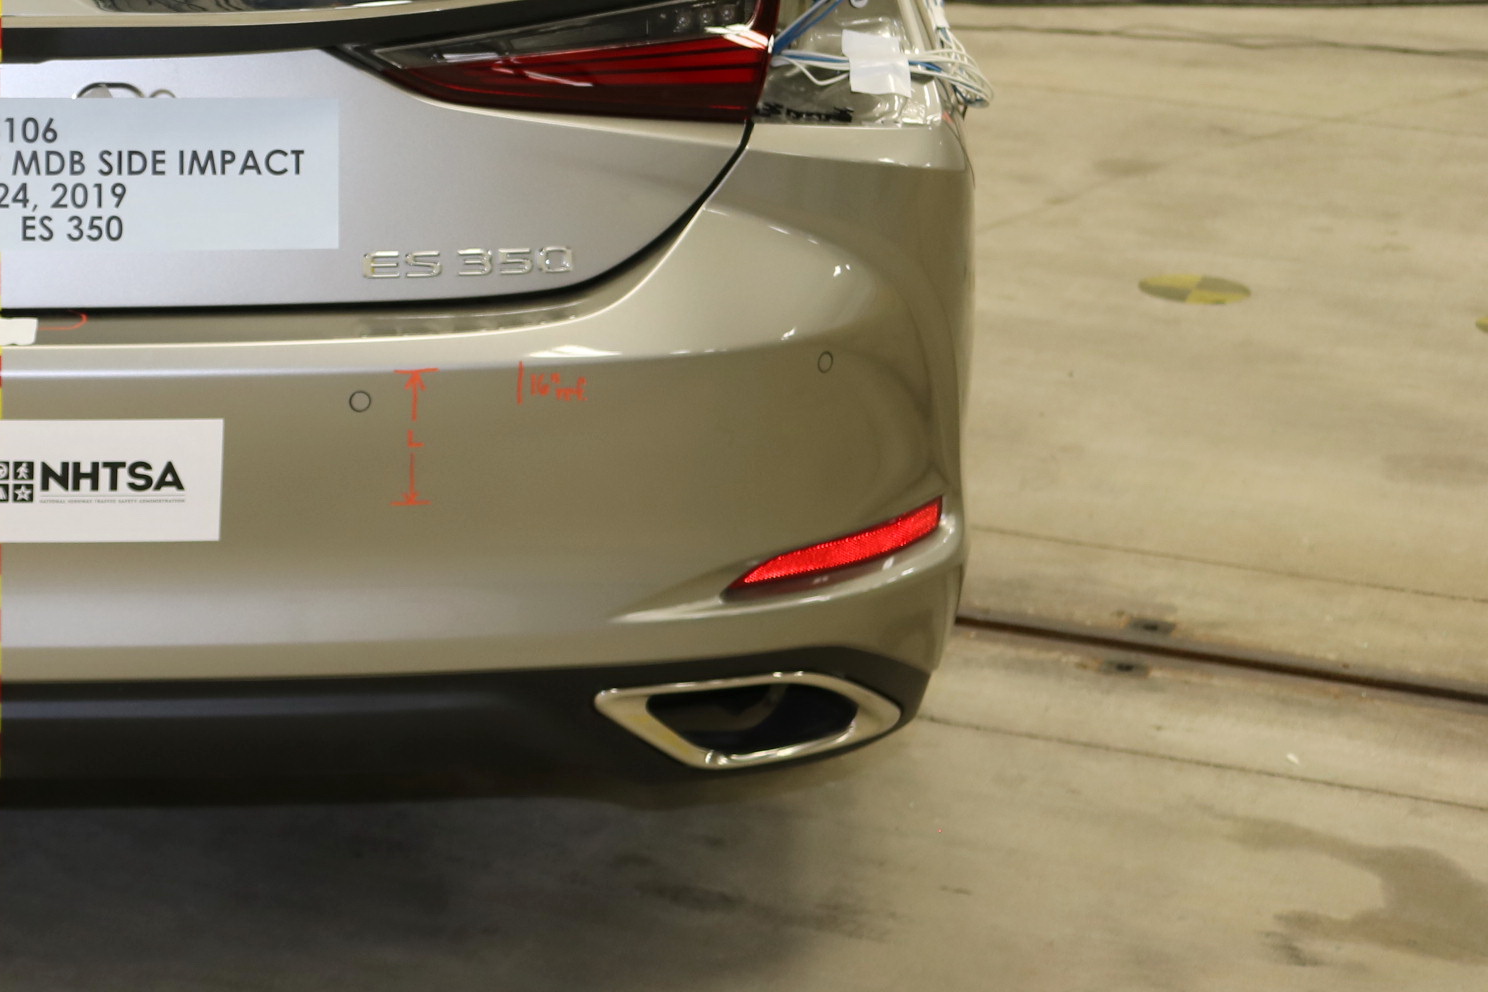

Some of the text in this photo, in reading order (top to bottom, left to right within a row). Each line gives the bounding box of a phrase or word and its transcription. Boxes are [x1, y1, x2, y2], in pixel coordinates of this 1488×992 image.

[12, 150, 86, 176] MDB
[98, 149, 166, 176] SIDE
[178, 149, 305, 176] IMPACT
[50, 182, 127, 209] 2019
[21, 215, 54, 242] ES
[66, 215, 123, 242] 350
[363, 245, 574, 279] ES 350
[40, 460, 186, 493] NHTSA
